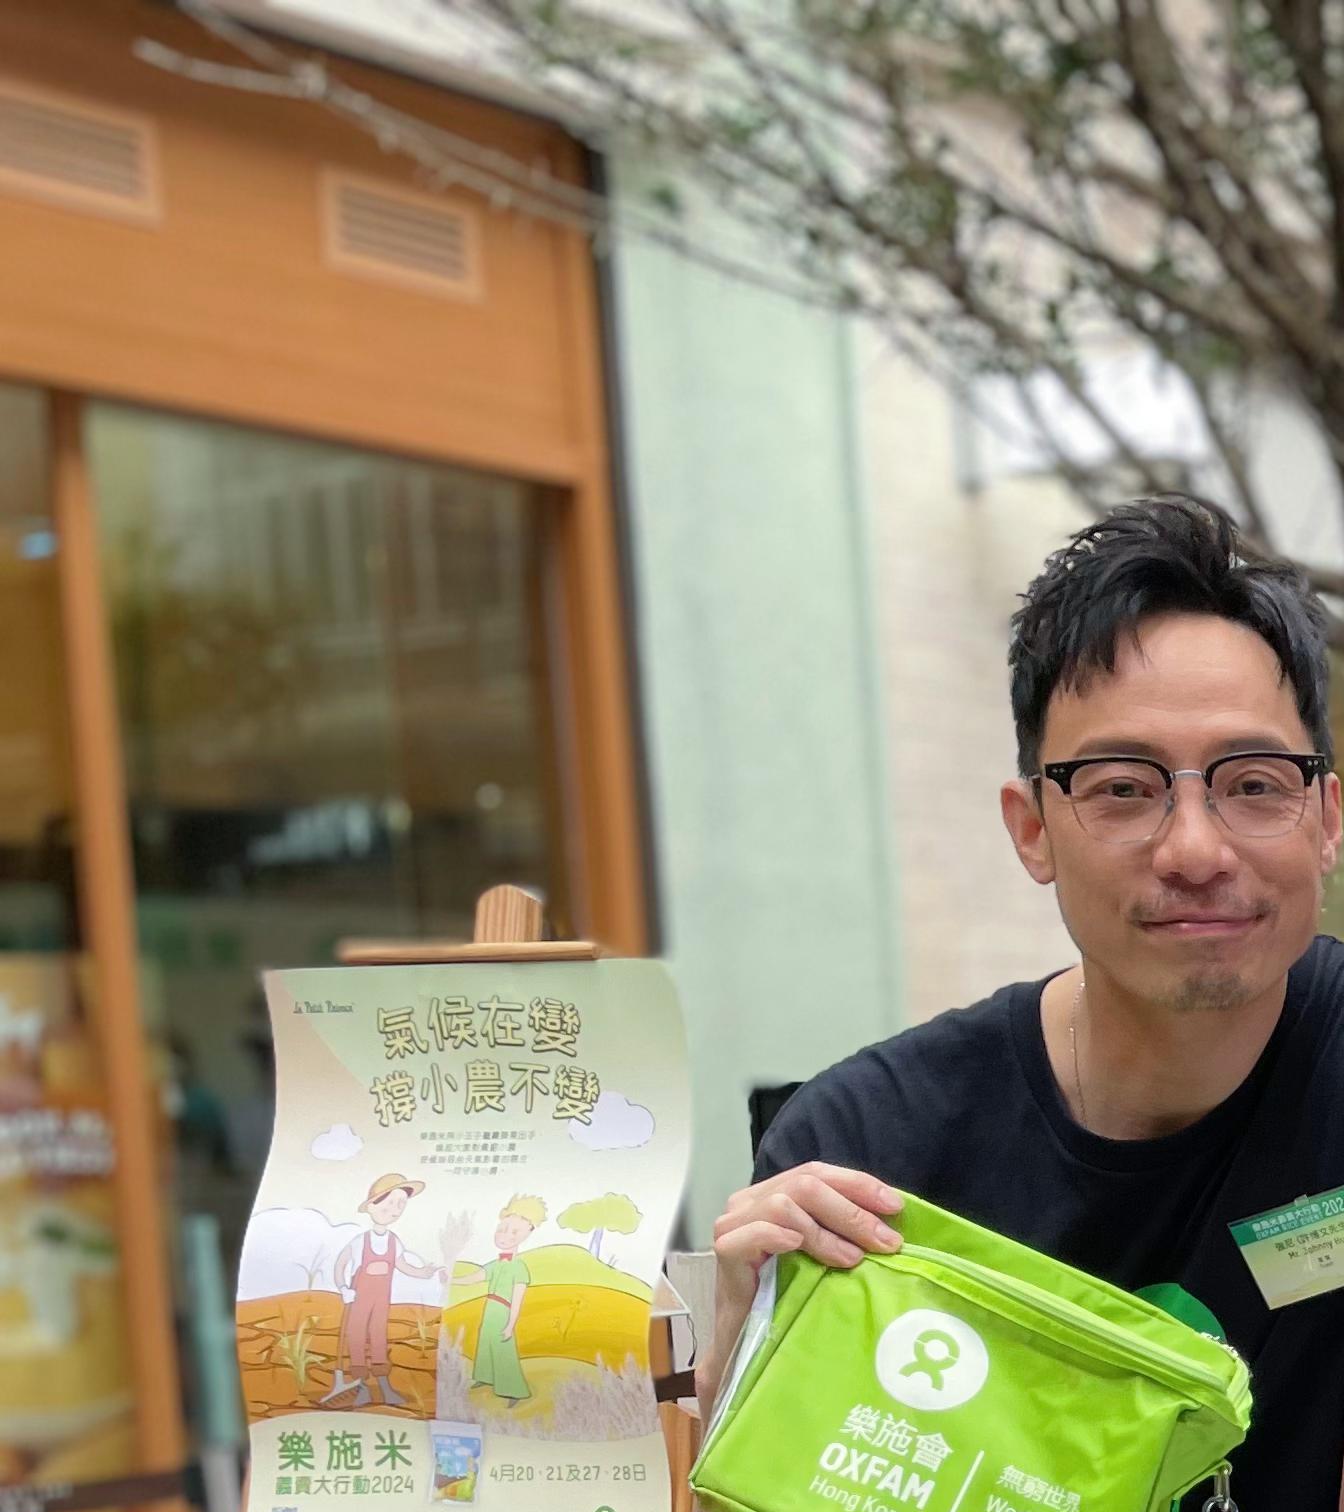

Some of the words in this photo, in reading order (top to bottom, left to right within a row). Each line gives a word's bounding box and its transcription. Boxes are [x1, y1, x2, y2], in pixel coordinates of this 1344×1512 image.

[377, 996, 582, 1059] 氣候在變
[370, 1059, 601, 1127] 撐小農不變
[277, 1429, 413, 1472] 樂施米
[839, 1404, 953, 1473] 樂施會
[819, 1441, 936, 1511] OXFAM
